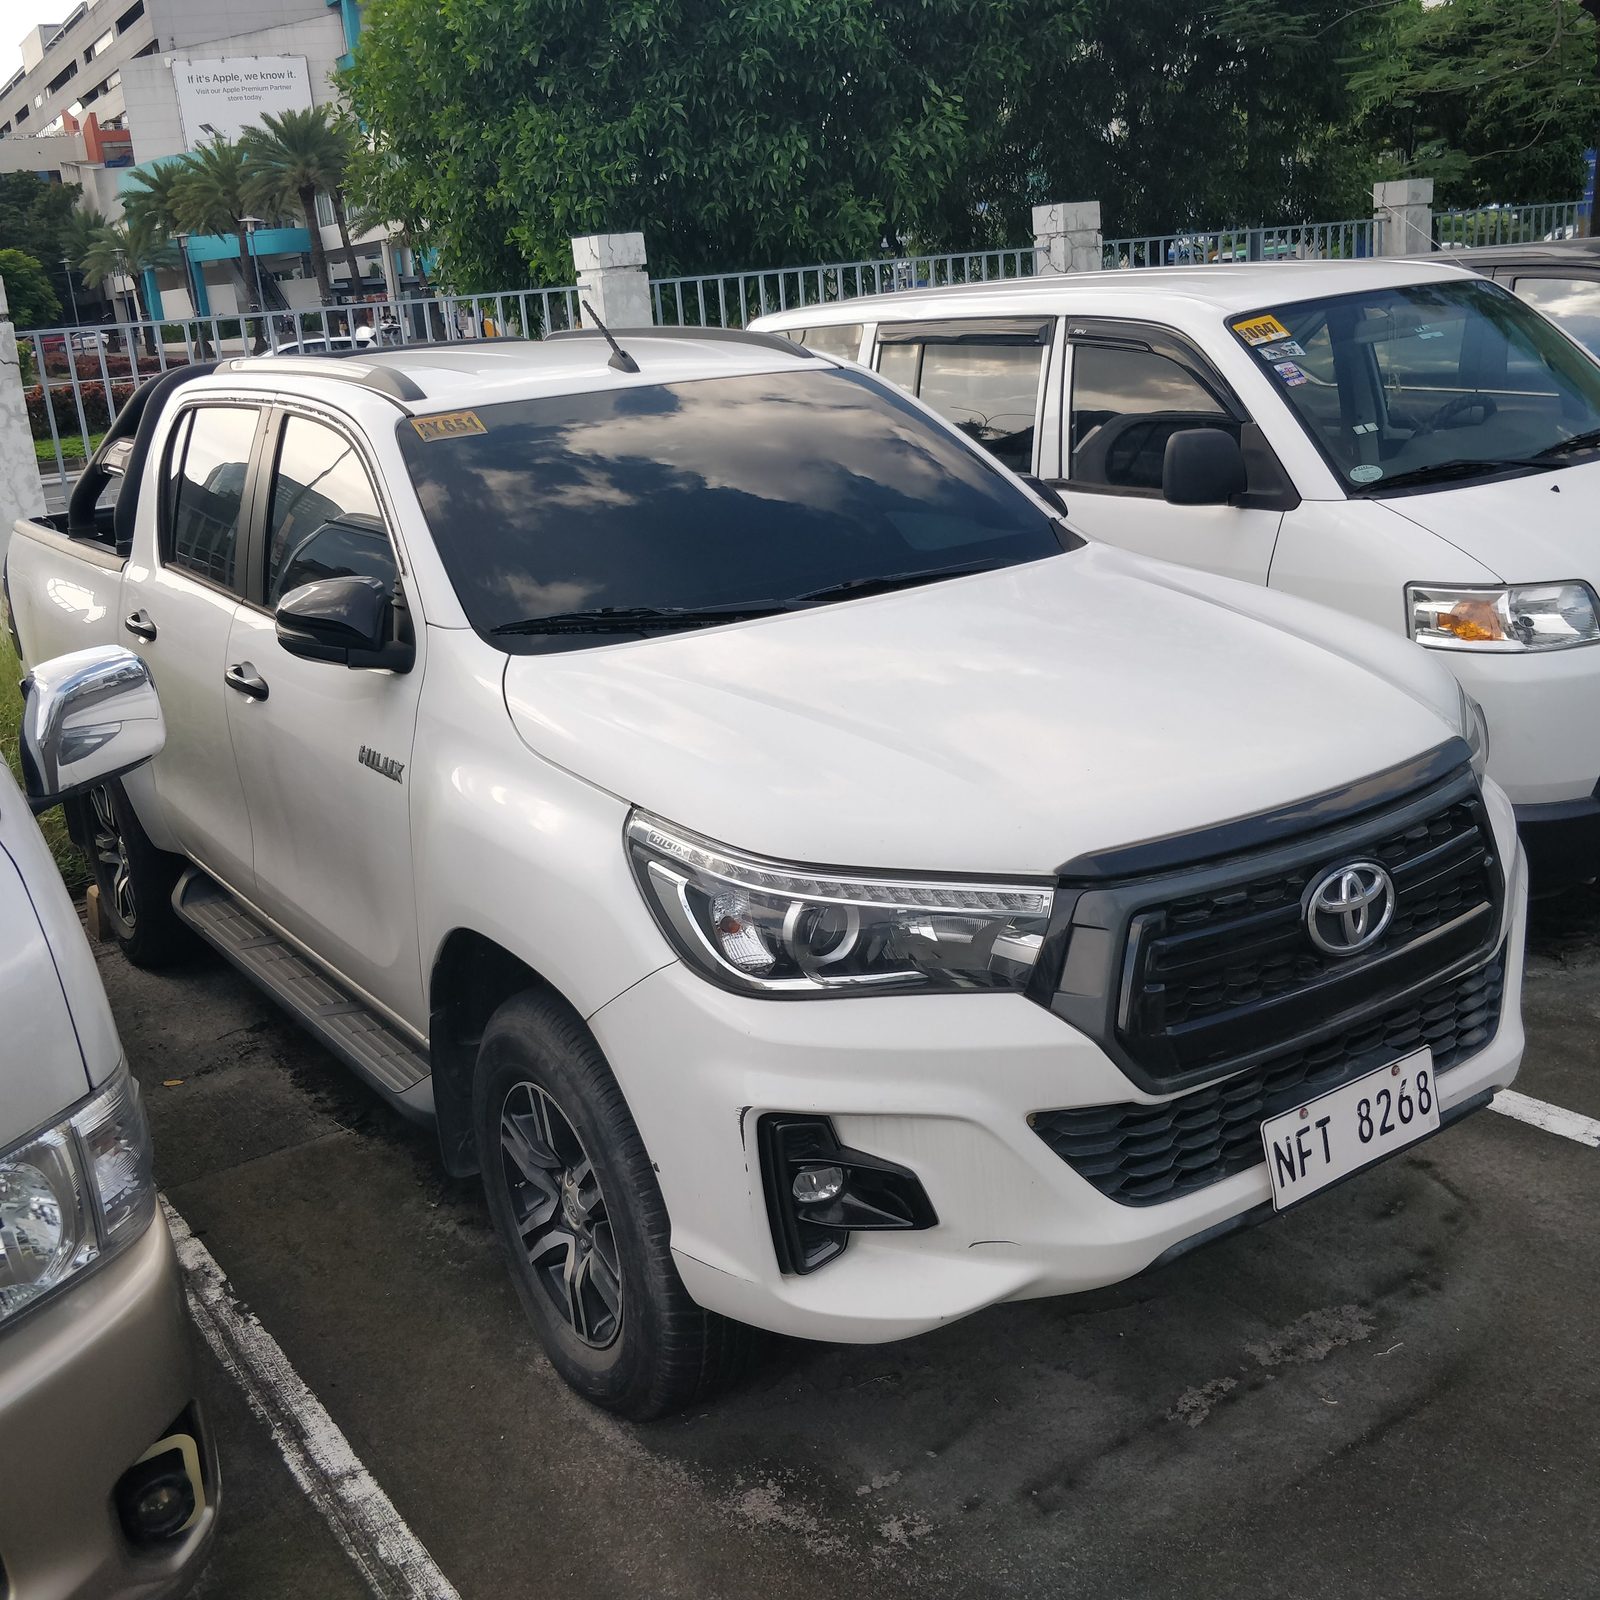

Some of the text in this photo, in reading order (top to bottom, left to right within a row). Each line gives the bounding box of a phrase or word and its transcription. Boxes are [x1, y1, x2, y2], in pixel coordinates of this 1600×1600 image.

[187, 69, 297, 84] If it's Apple, we know it.
[222, 86, 241, 94] Apple
[244, 94, 264, 102] today.
[358, 744, 406, 785] HILUX
[1272, 1070, 1432, 1189] NFT 8268
